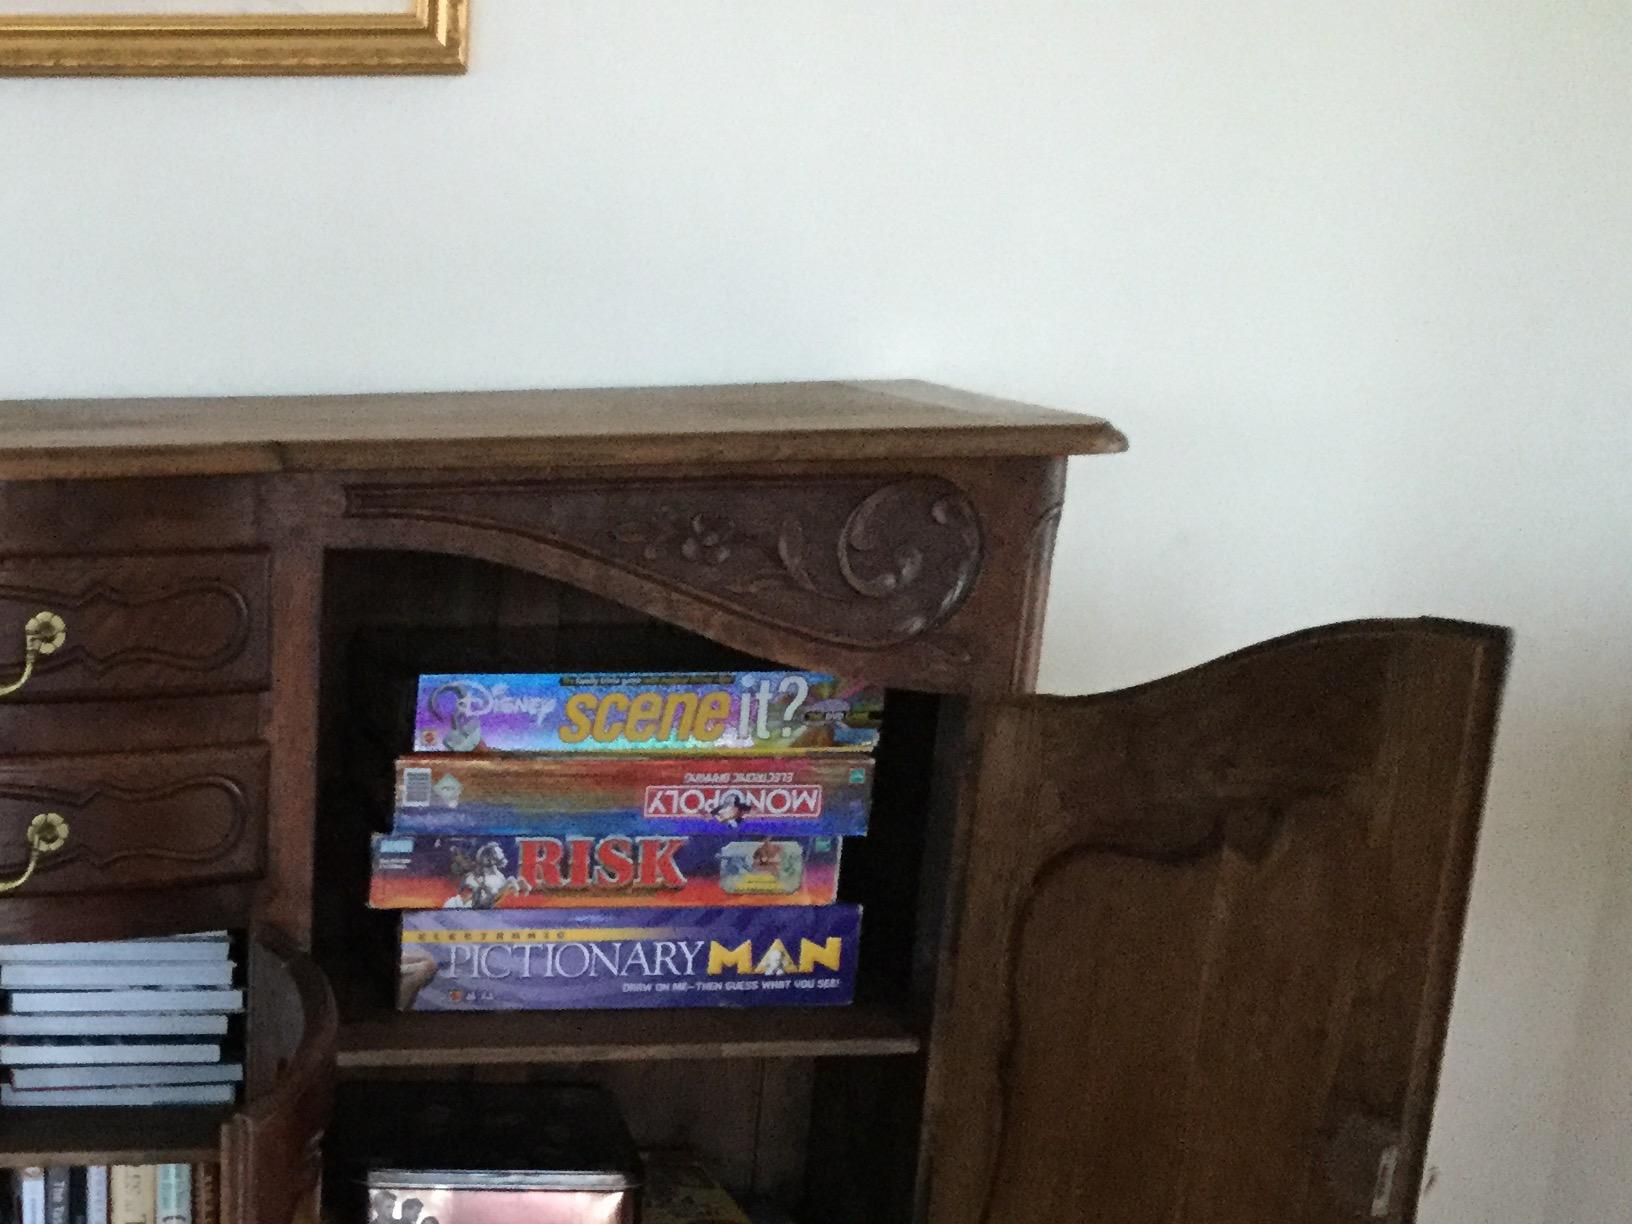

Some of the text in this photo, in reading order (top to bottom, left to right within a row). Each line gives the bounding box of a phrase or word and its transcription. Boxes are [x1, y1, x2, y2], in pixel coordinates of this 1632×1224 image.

[559, 674, 809, 744] scene it?
[648, 789, 817, 815] MONOPOLY
[518, 836, 689, 888] RISK
[445, 936, 842, 979] PICTIONARY MAN
[52, 1181, 65, 1202] The
